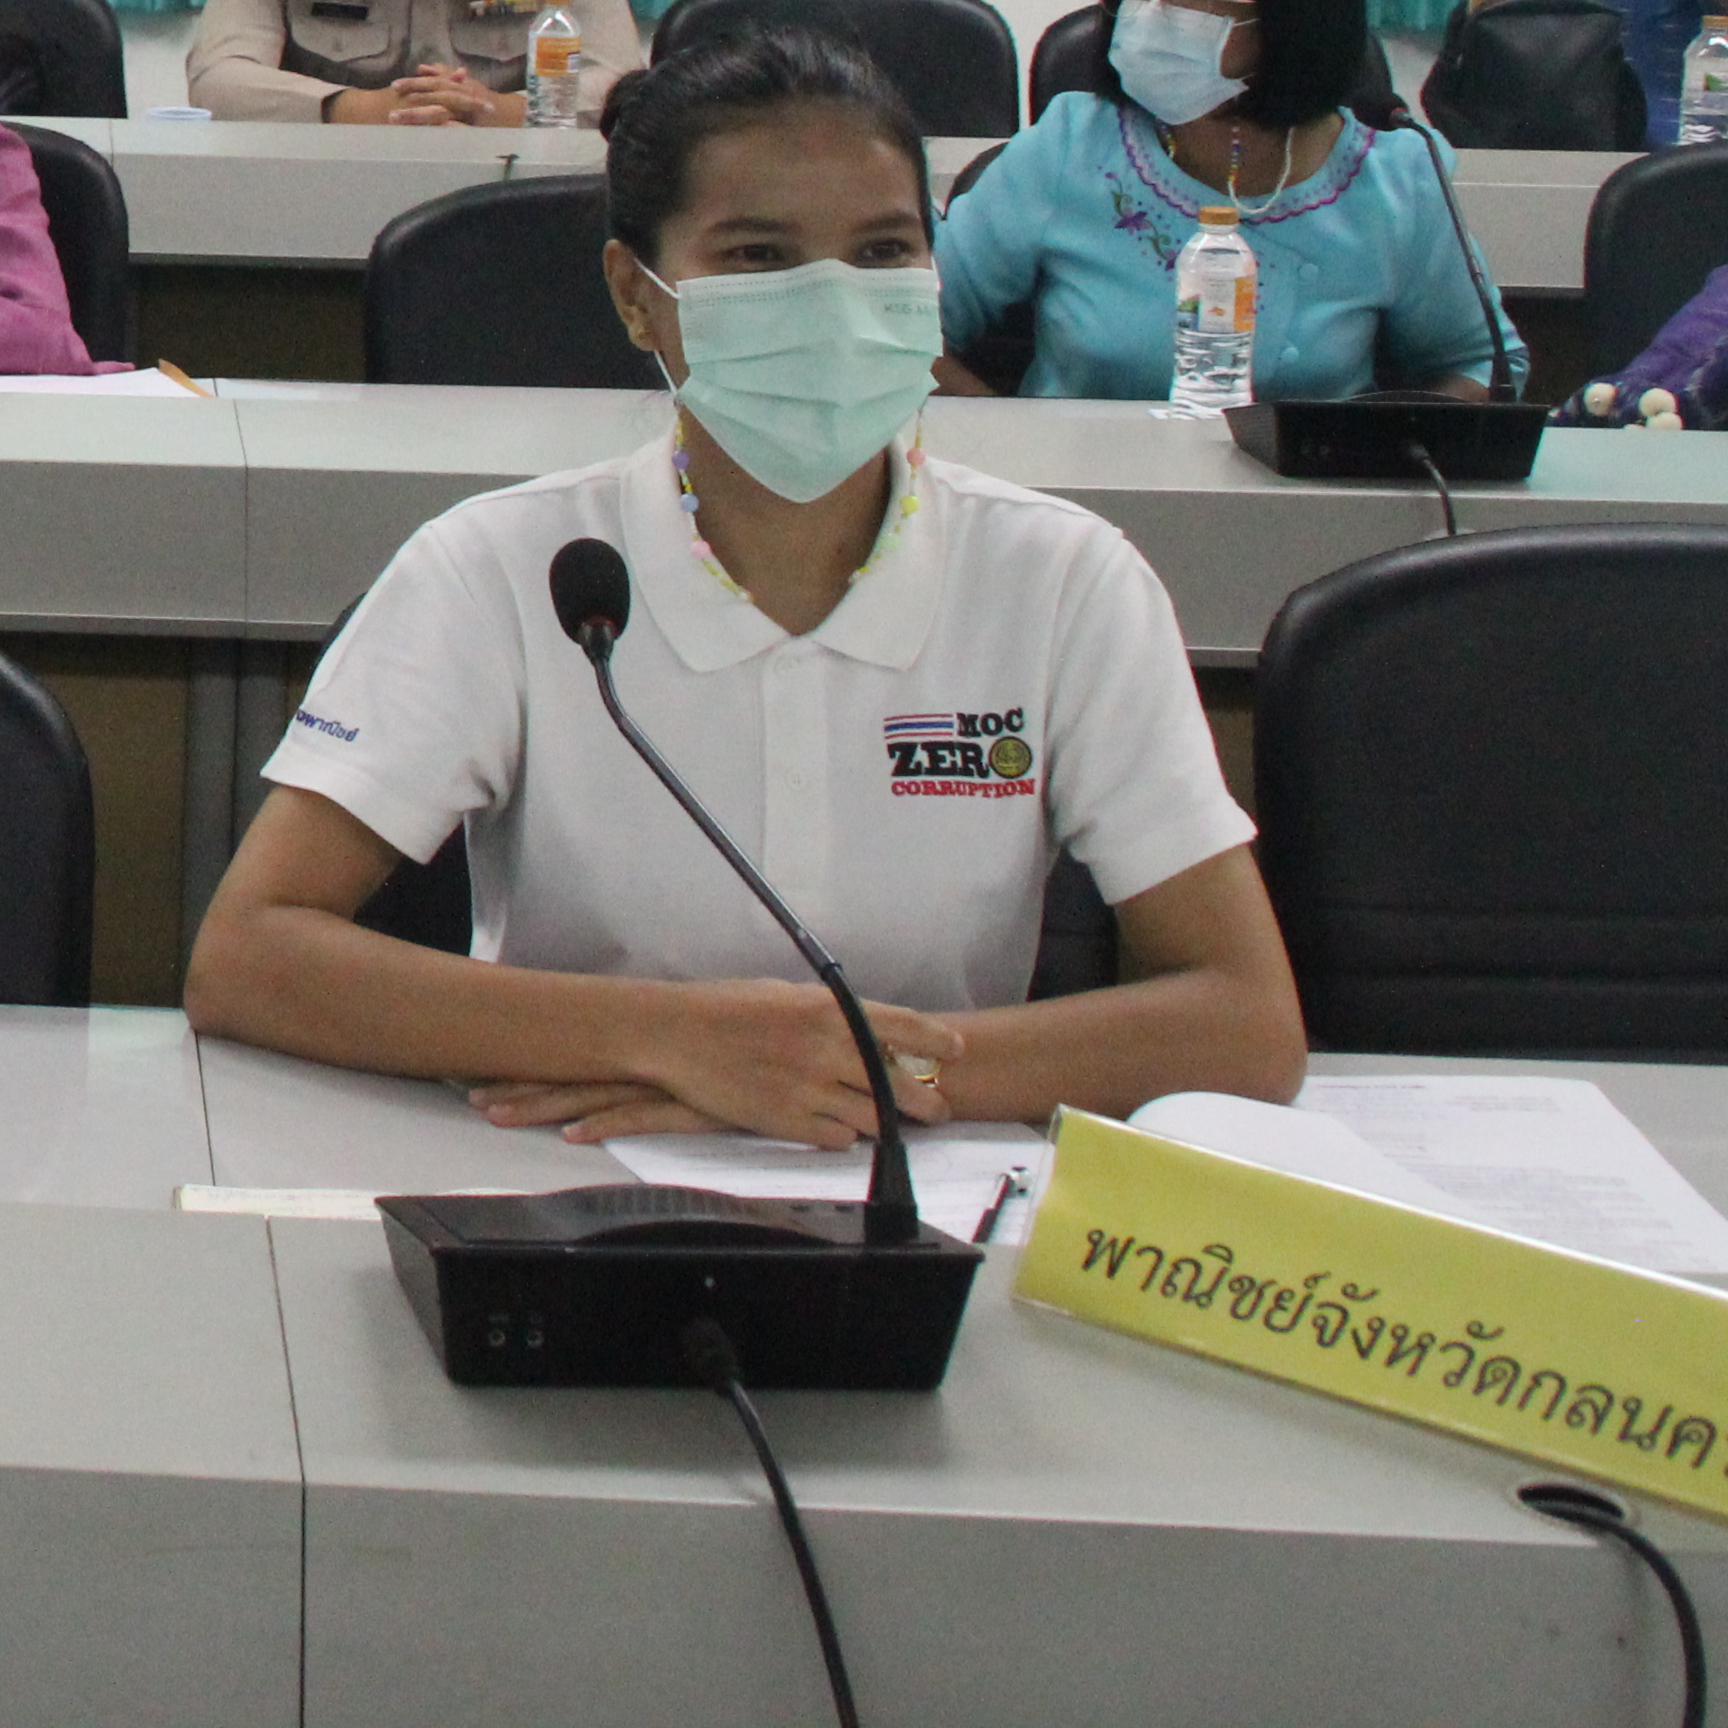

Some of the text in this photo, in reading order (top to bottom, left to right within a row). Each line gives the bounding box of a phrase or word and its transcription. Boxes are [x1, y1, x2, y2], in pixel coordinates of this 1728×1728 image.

[956, 707, 1024, 737] MOC
[892, 779, 1035, 798] CORRUPTION
[1080, 1227, 1728, 1479] พาณิชย์จังหวัดกลนค
